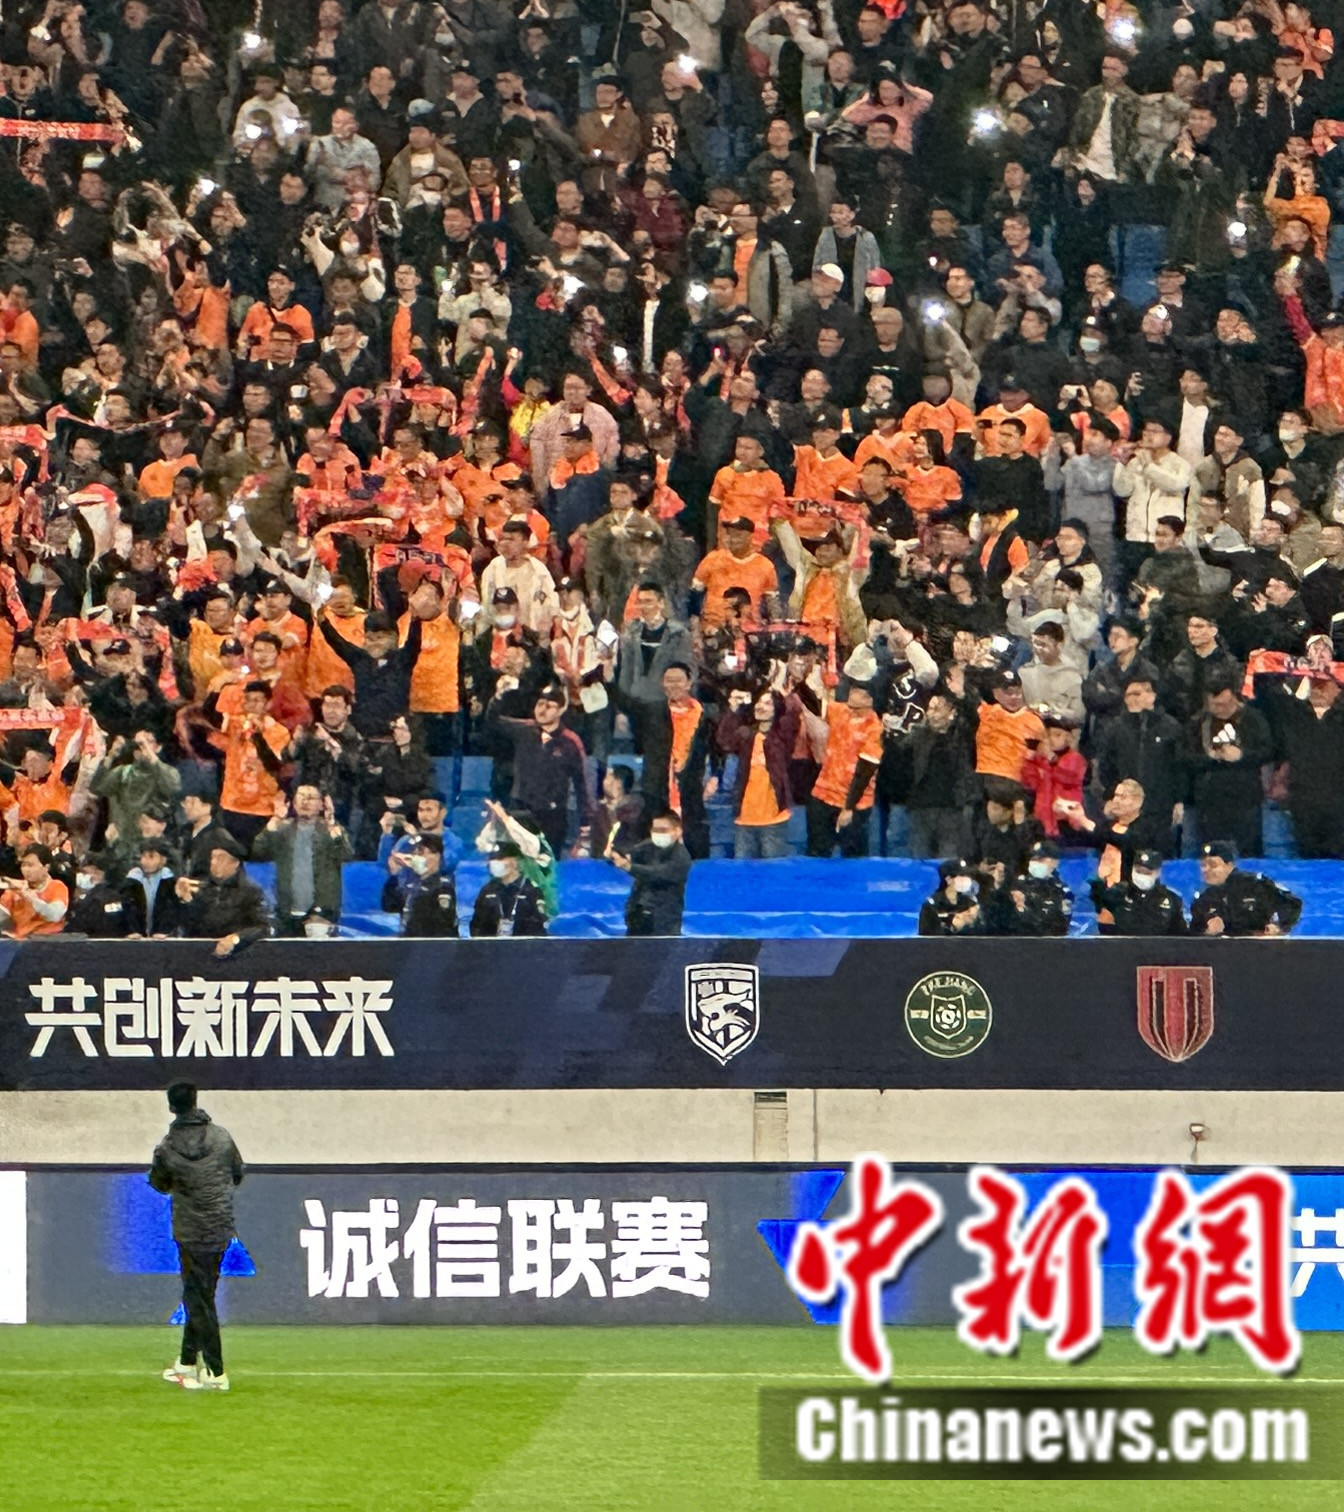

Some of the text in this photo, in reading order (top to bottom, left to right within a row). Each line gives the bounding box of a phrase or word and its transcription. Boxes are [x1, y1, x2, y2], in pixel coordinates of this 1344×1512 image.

[23, 975, 395, 1058] 共创新未来
[298, 1196, 711, 1301] 诚信联赛
